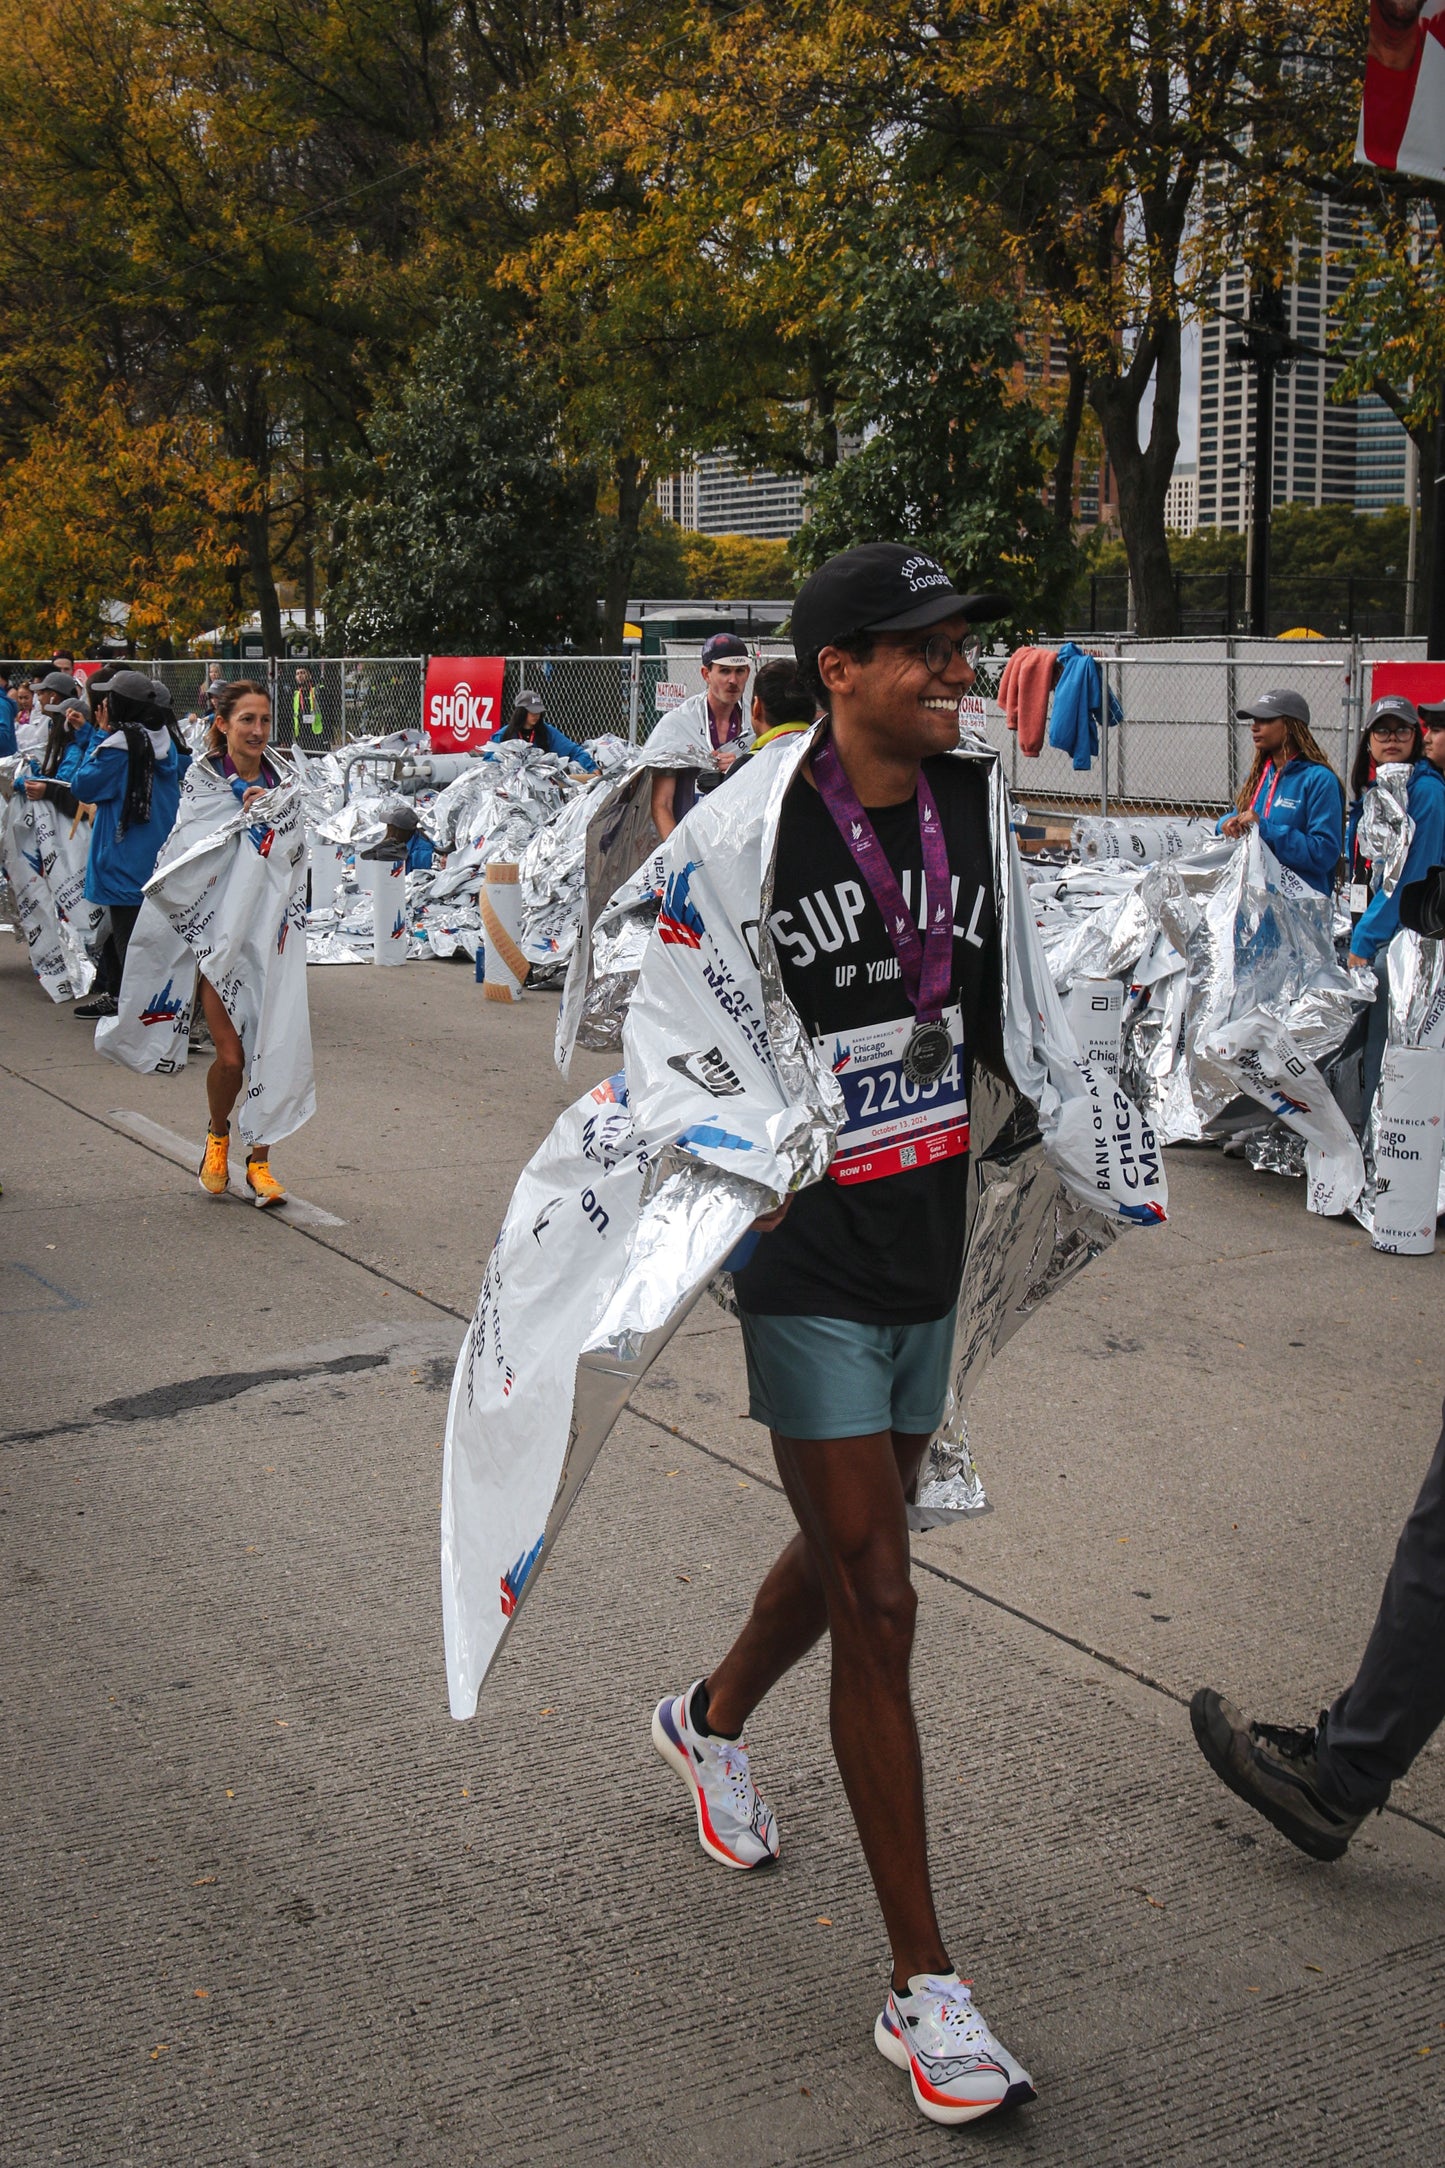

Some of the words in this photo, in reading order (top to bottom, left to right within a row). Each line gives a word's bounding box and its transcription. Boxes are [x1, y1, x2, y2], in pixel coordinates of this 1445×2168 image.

[430, 694, 494, 729] SHOKZ
[1130, 833, 1140, 854] RUN
[43, 850, 58, 867] RUN
[88, 907, 104, 923] RUN
[769, 880, 865, 967] SUP
[29, 924, 42, 941] RUN
[836, 965, 857, 988] UP
[853, 1041, 886, 1055] Chicago
[854, 1049, 893, 1064] Marathon
[871, 1125, 898, 1137] October
[899, 1120, 911, 1132] 13,
[911, 1114, 928, 1127] 2024
[1093, 1104, 1103, 1130] OF
[1388, 1117, 1426, 1127] AMERICA
[840, 1166, 860, 1178] ROW
[862, 1163, 873, 1174] 10
[1097, 1136, 1110, 1190] BANK
[1381, 1228, 1417, 1238] AMERICA
